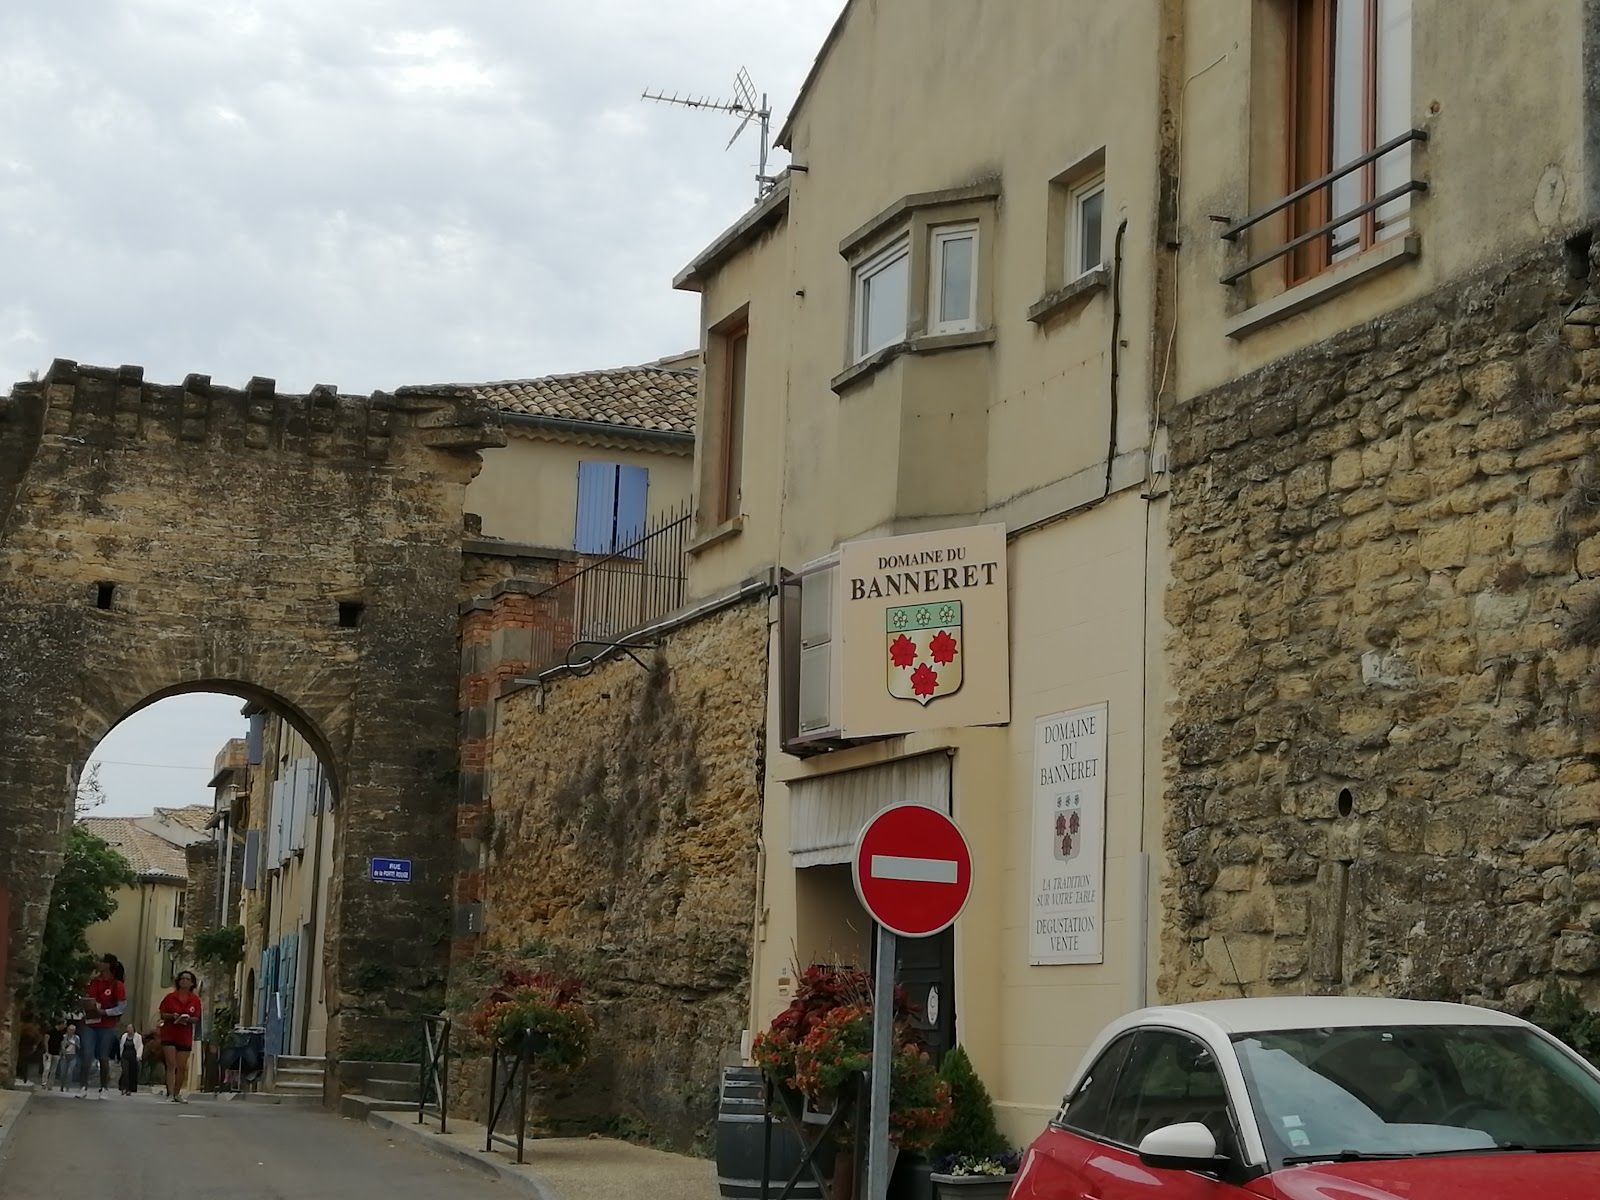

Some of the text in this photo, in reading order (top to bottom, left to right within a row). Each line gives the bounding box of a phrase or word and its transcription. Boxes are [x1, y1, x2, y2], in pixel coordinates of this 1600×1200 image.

[878, 547, 966, 569] DOMAINE DU
[851, 562, 998, 600] BANNERET
[1044, 716, 1097, 744] DOMAINE
[1060, 742, 1078, 762] DU
[1040, 758, 1099, 786] BANNERET
[1042, 874, 1091, 891] LA TRADITION
[1037, 889, 1096, 907] SUR VOTRE TABLE
[1036, 916, 1095, 935] DEGUSTATION
[1050, 936, 1079, 952] VENTE
